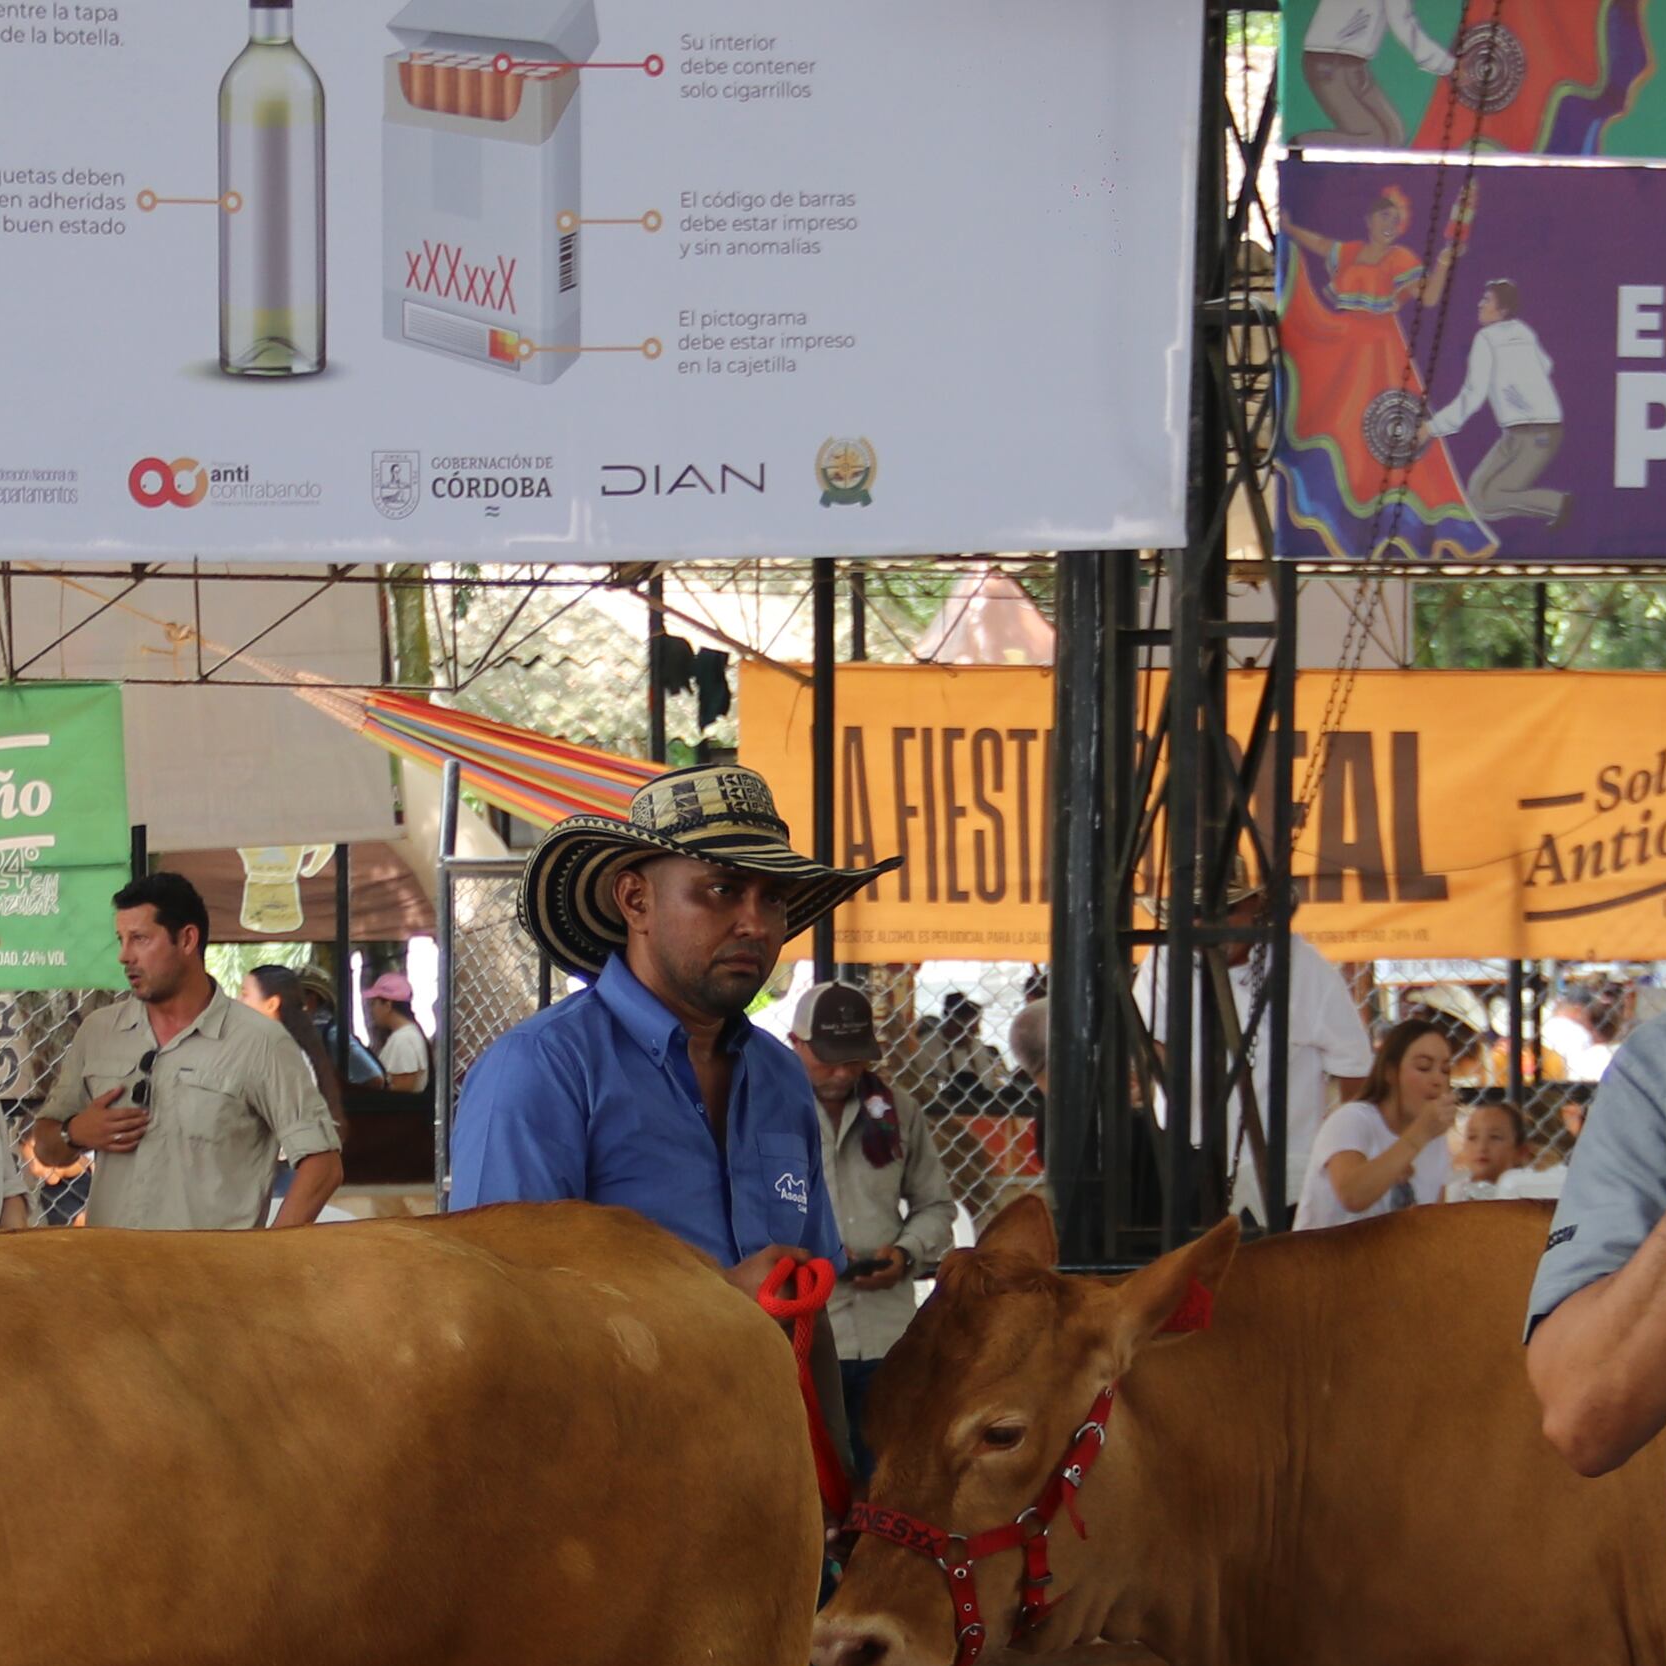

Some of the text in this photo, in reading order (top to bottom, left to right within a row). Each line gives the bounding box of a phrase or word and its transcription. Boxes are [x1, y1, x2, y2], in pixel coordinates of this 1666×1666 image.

[53, 2, 70, 21] la
[75, 5, 119, 25] tapa
[0, 25, 26, 43] de
[31, 26, 47, 44] la
[53, 26, 125, 47] botella.
[679, 33, 777, 52] Su interior
[680, 57, 816, 76] debe contener
[680, 80, 813, 103] solo cigarrillos
[61, 168, 126, 186] deben
[680, 190, 857, 212] El código de barras
[2, 215, 54, 233] buen
[58, 217, 127, 236] estado
[679, 214, 859, 235] debe estar impreso
[678, 238, 822, 260] y sin anomalías
[678, 310, 808, 330] El pictograma
[678, 332, 857, 353] debe estar impreso
[677, 357, 798, 378] en la cajetilla
[430, 453, 554, 470] GOBERNACIÓN DE
[210, 465, 250, 482] anti
[600, 462, 765, 496] DIAN
[210, 481, 323, 499] contrabando
[430, 471, 554, 499] CÓRDOBA
